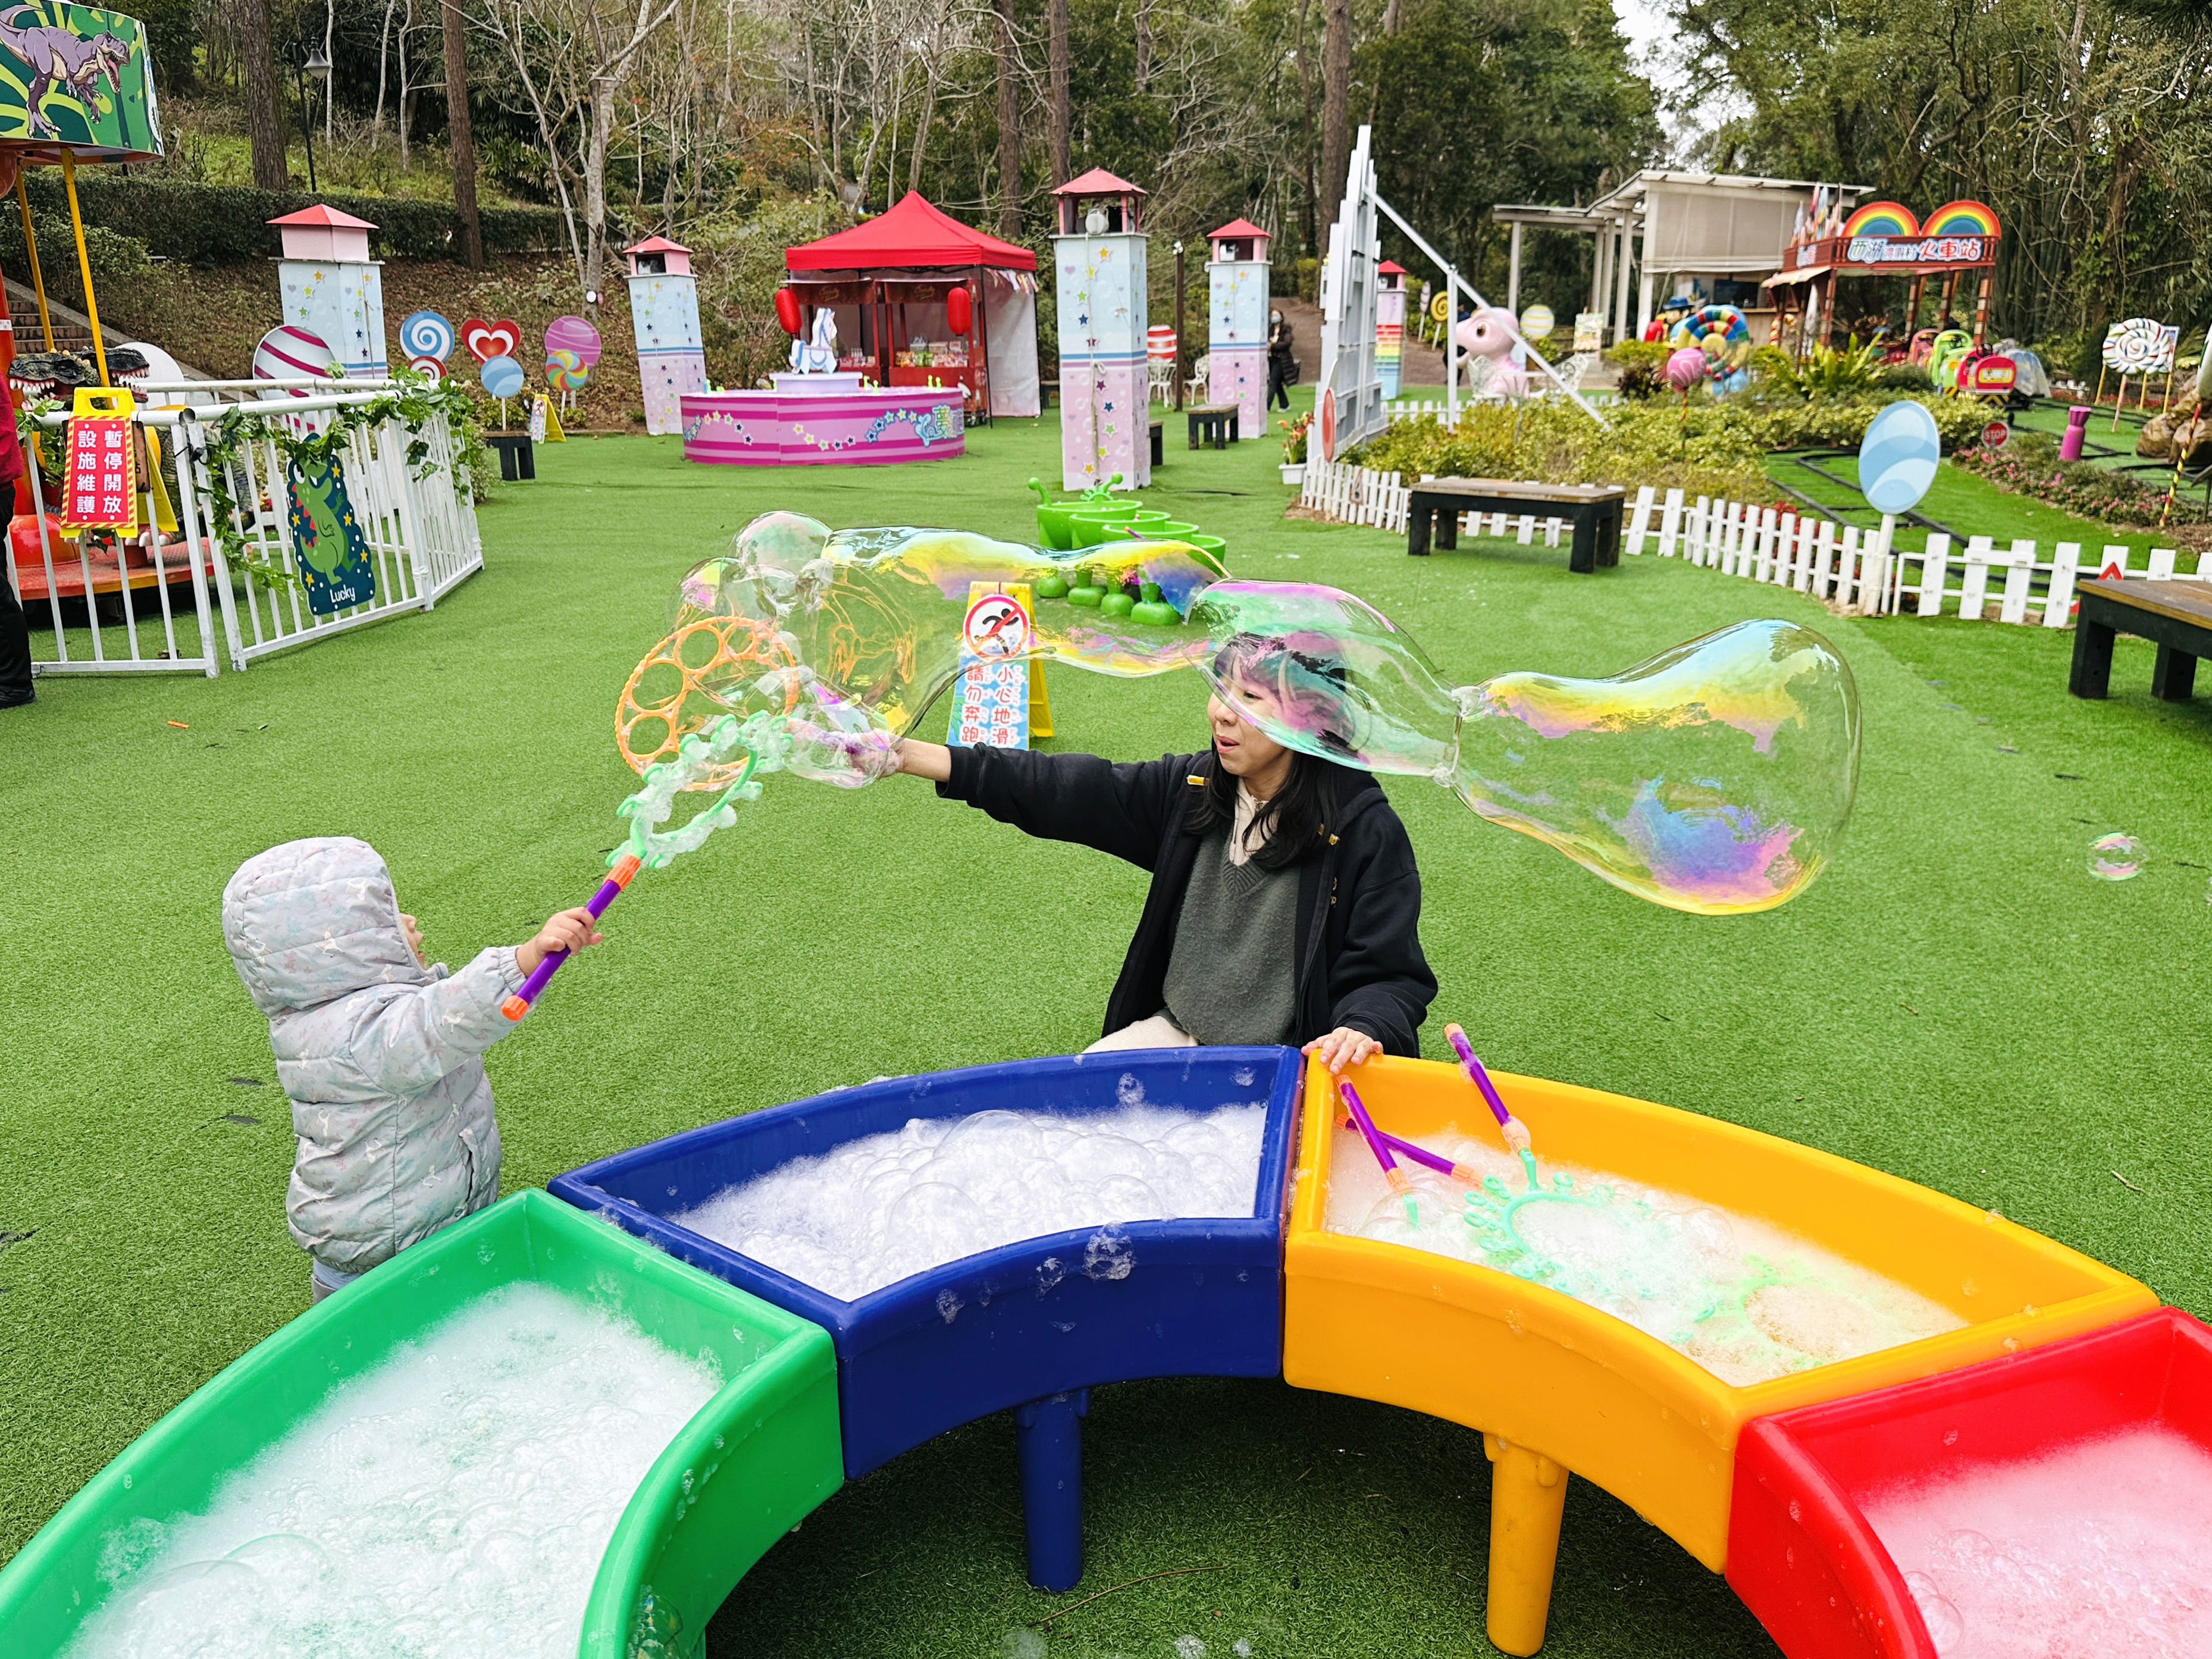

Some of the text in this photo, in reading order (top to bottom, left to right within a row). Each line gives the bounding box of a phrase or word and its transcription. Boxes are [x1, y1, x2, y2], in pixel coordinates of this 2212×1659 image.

[76, 430, 96, 514] 設施維護
[103, 430, 123, 514] 暫停開放
[1984, 429, 2006, 440] STOP
[330, 584, 356, 603] Lucky
[961, 666, 984, 743] 請勿奔跑
[992, 666, 1013, 745] 小心地滑
